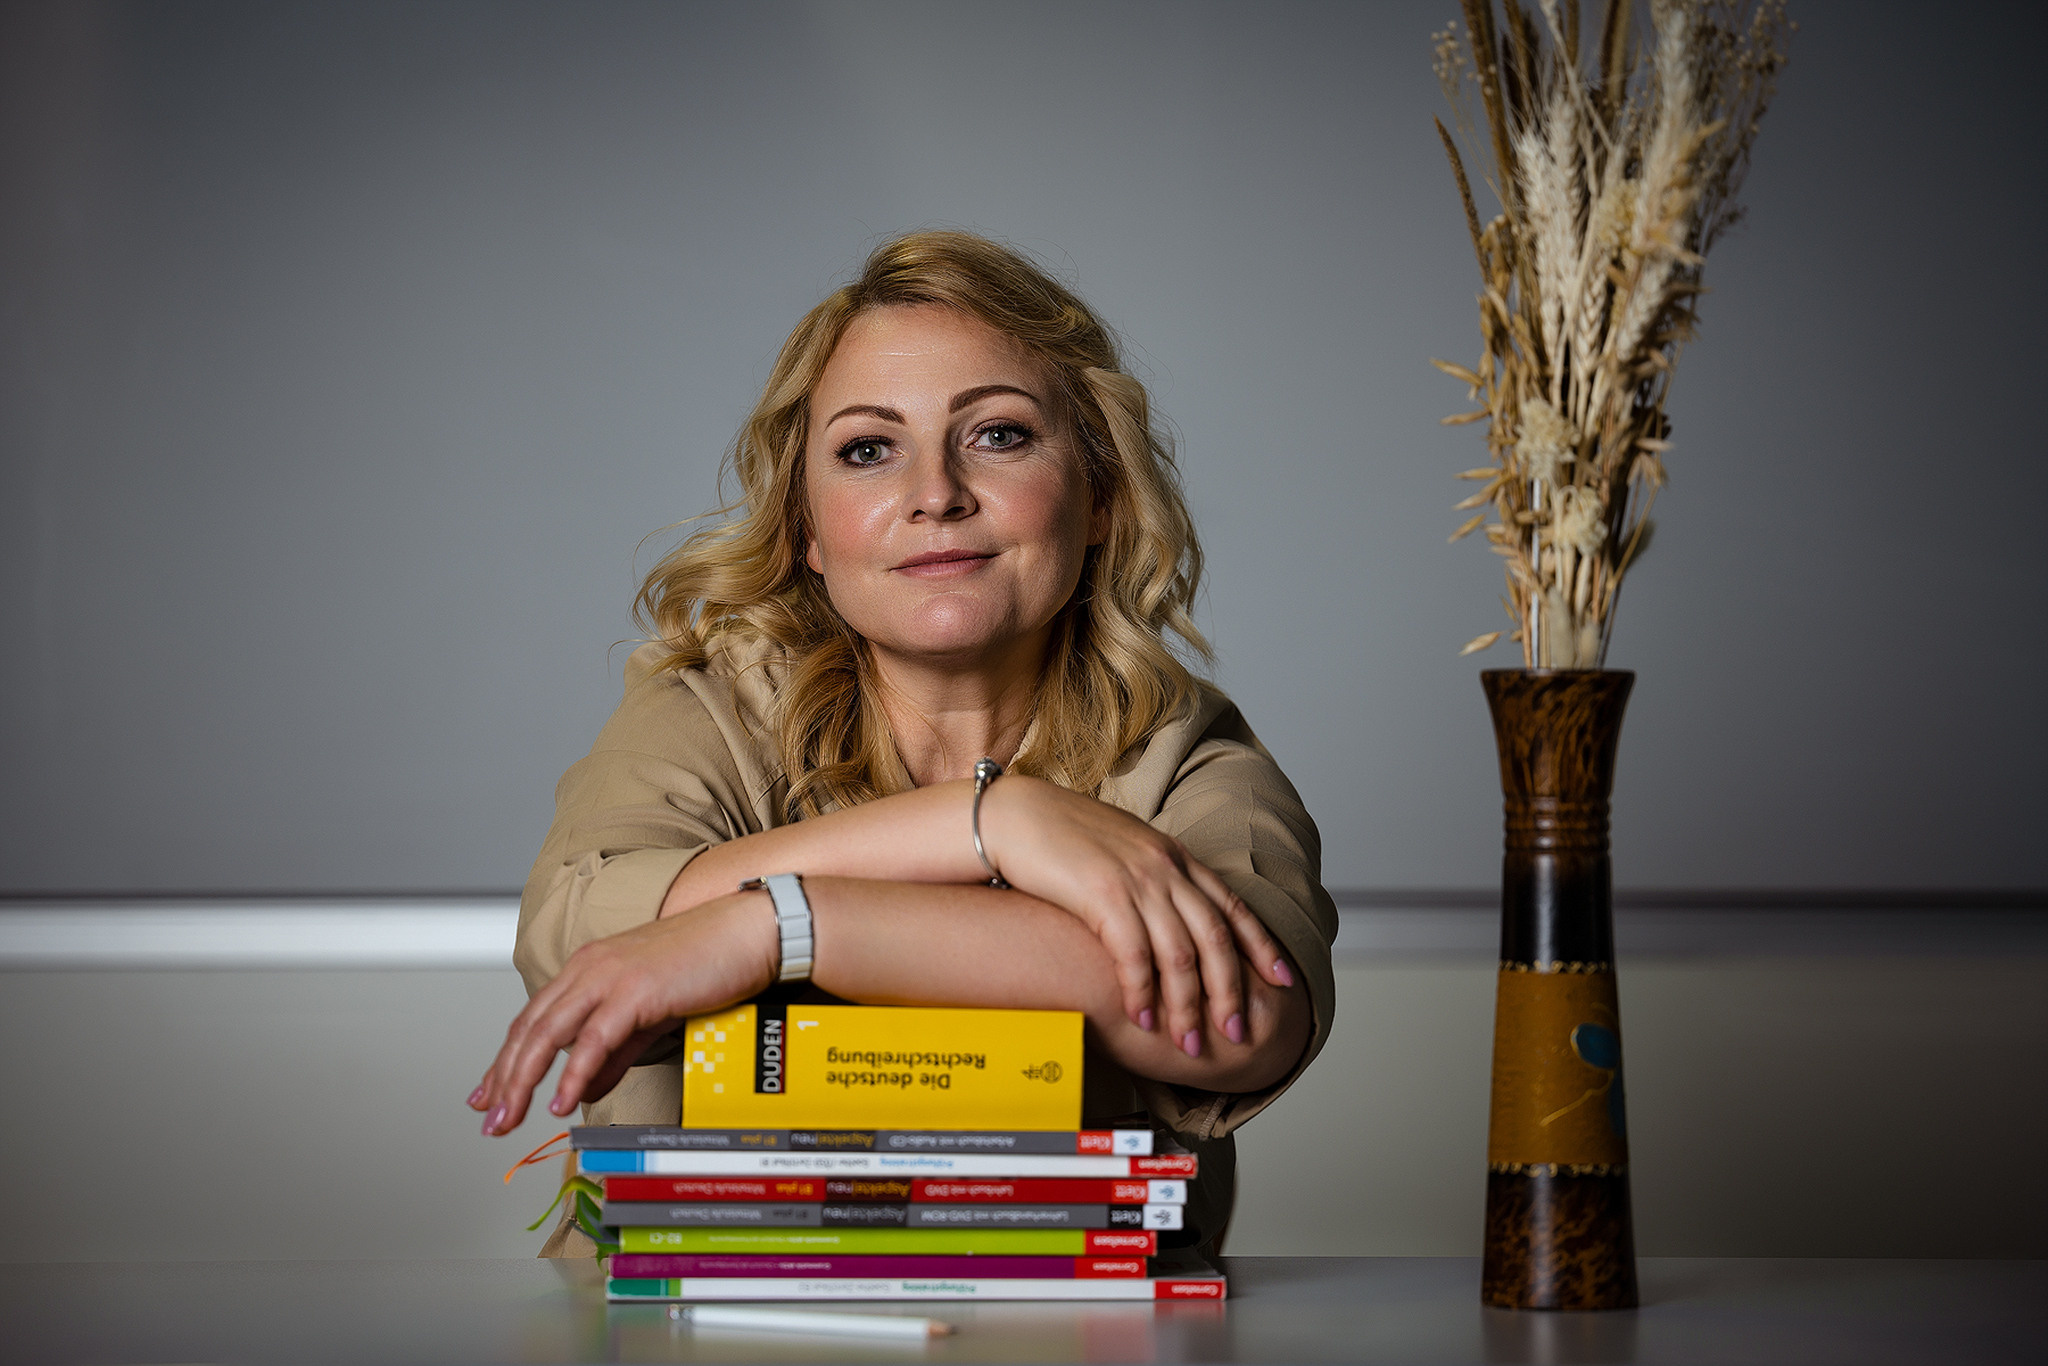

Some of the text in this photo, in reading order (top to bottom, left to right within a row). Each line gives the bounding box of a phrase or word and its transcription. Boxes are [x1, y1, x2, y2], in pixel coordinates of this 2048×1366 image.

[797, 1020, 819, 1030] 1
[762, 1020, 782, 1092] DUDEN
[826, 1047, 986, 1069] Rechtschreibung
[826, 1072, 951, 1089] Die deutsche
[1080, 1135, 1111, 1149] Klett
[1138, 1159, 1193, 1171] Cornelsen
[776, 1181, 798, 1195] plus
[925, 1184, 948, 1196] DVD
[1115, 1185, 1147, 1198] Klett
[1111, 1211, 1142, 1224] Klett
[1094, 1235, 1148, 1248] Cornelsen
[1093, 1262, 1139, 1273] Cornelsen
[1171, 1284, 1218, 1295] Cornelsen
